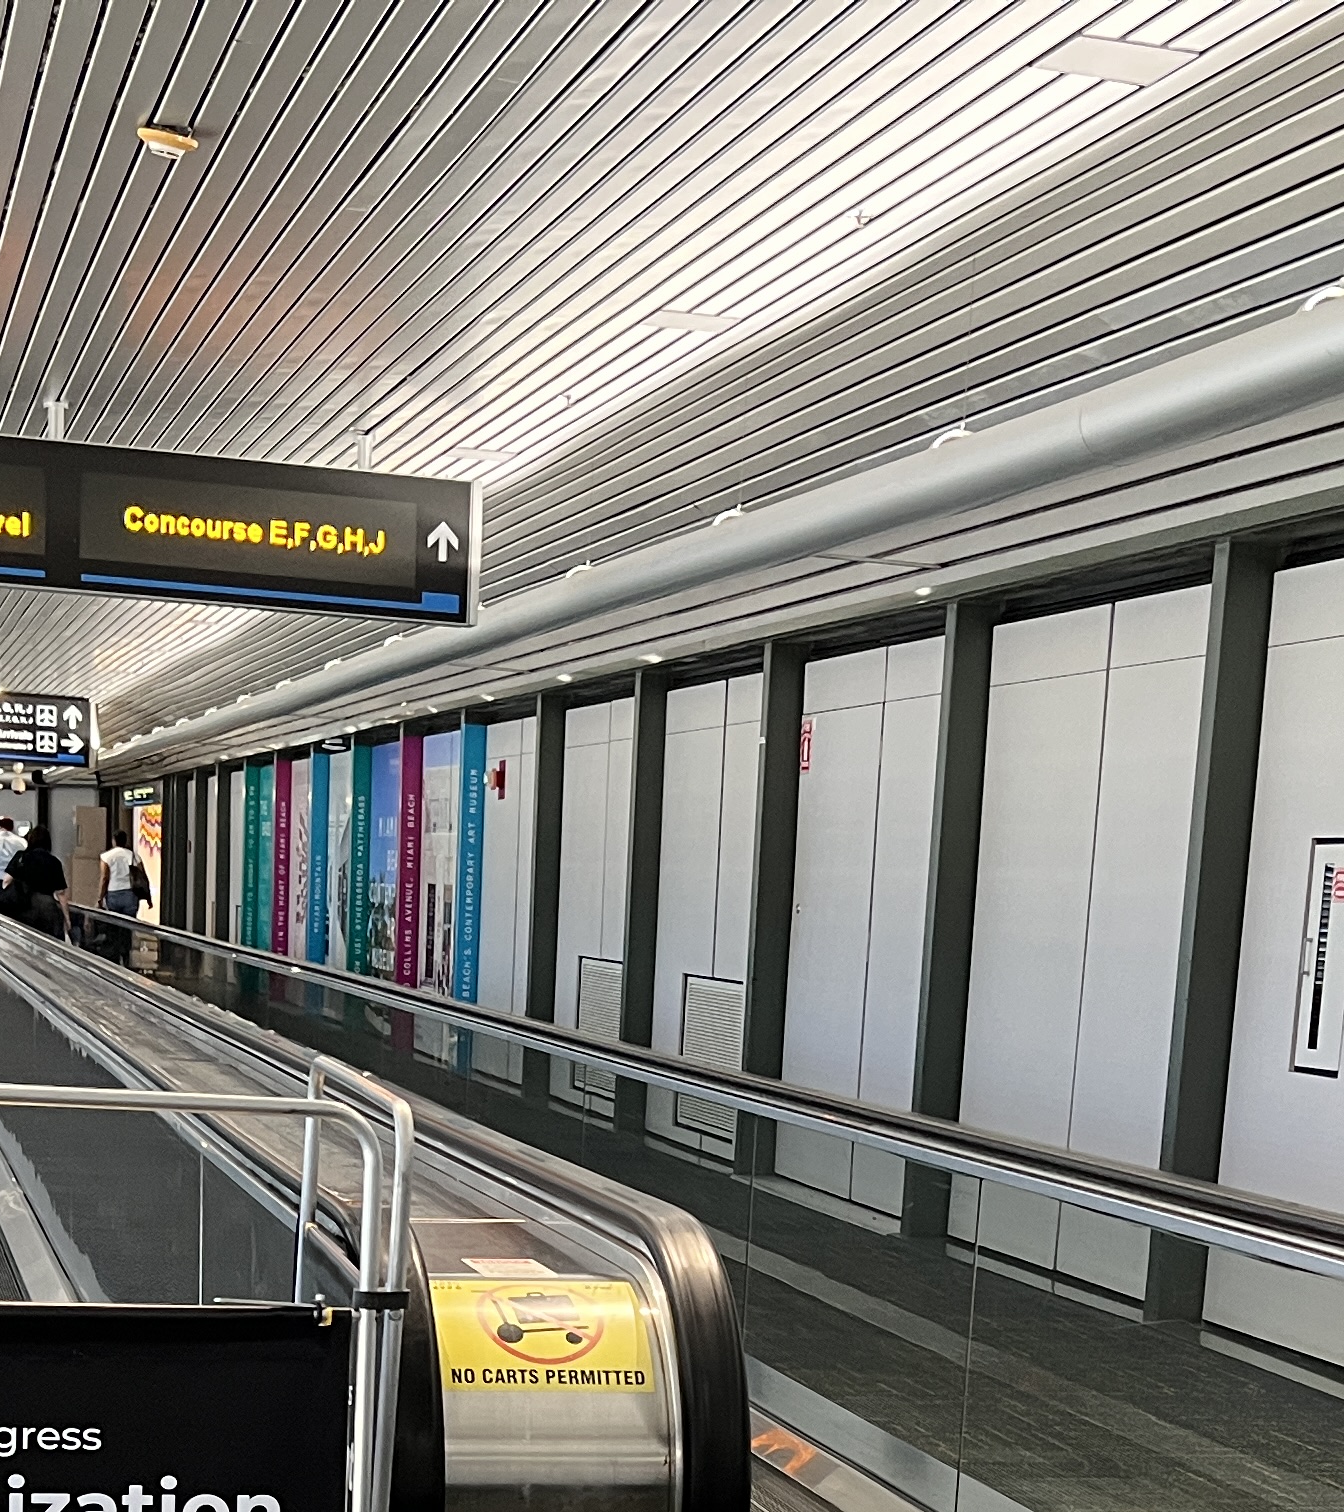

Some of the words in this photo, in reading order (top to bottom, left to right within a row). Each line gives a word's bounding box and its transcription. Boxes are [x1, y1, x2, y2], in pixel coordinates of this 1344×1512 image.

[123, 505, 264, 543] Concourse
[268, 518, 386, 557] E,F,G,H,J
[407, 794, 416, 828] BEACH
[468, 768, 478, 814] MUSEUM
[406, 836, 415, 869] MIAMI
[467, 822, 476, 845] ART
[465, 852, 475, 941] CONTEMPORARY
[403, 930, 412, 976] COLLINS
[451, 1368, 475, 1384] NO
[482, 1368, 539, 1385] CARTS
[546, 1369, 645, 1386] PERMITTED
